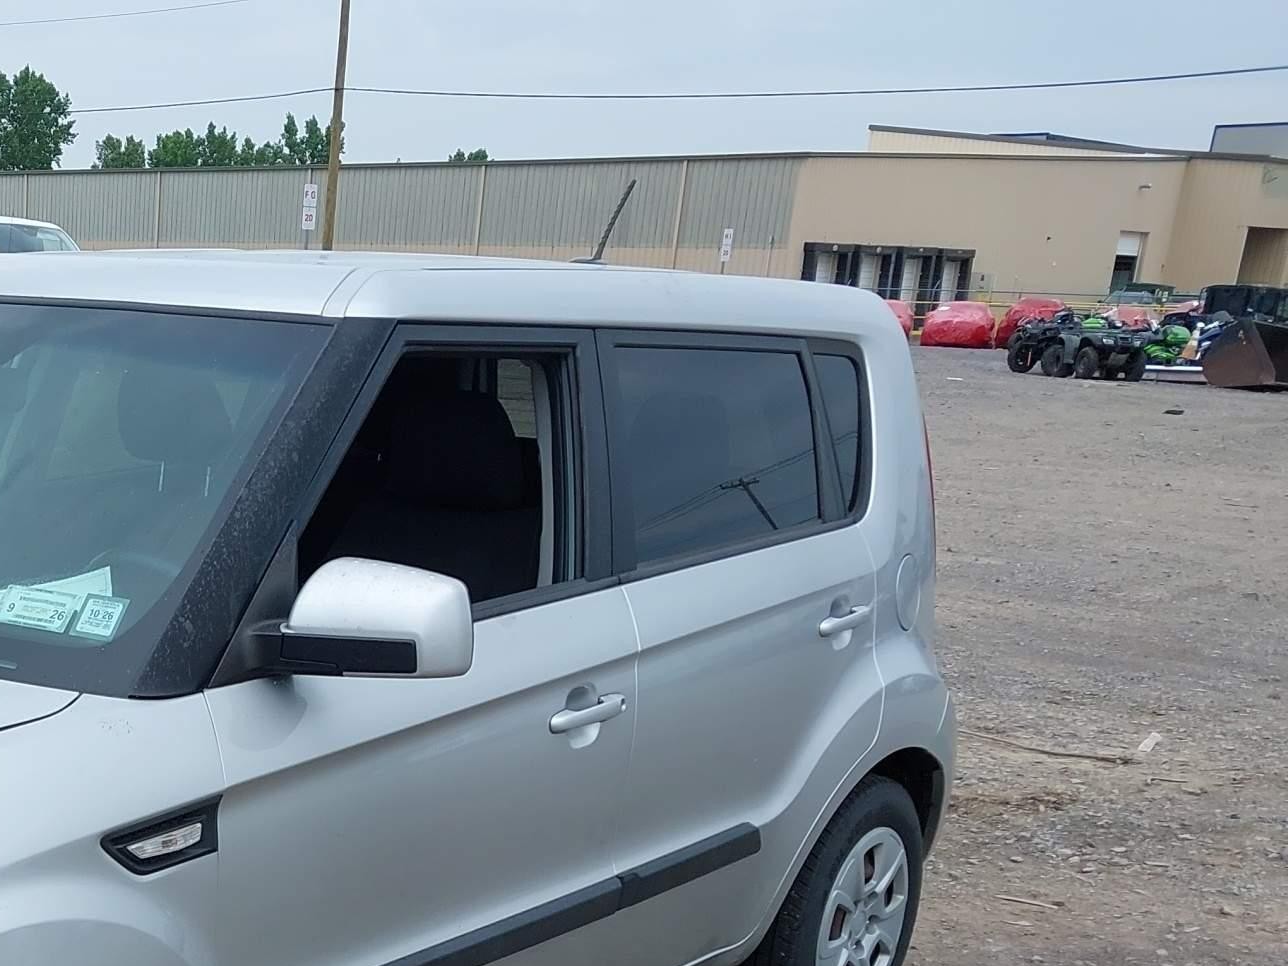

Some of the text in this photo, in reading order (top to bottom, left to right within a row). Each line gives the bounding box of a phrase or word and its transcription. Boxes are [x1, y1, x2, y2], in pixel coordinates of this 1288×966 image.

[6, 602, 16, 613] 9
[49, 609, 65, 621] 26
[89, 609, 114, 620] 10 26
